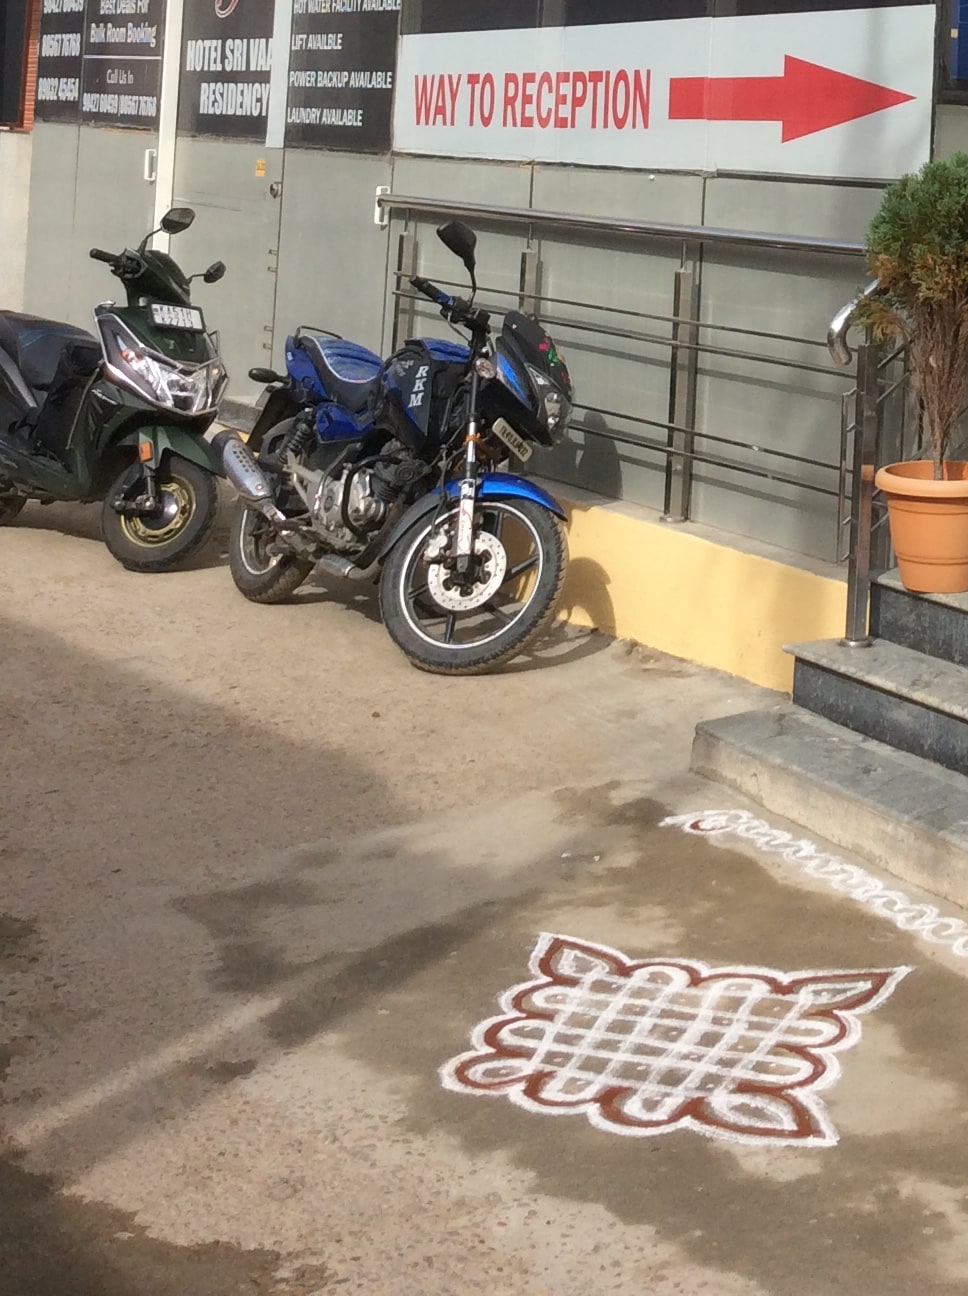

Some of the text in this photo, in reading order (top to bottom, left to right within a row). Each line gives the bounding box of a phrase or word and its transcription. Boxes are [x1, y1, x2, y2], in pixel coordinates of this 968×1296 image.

[186, 39, 222, 71] HOTEL
[224, 38, 247, 71] SRI
[291, 34, 307, 50] LIFT
[289, 71, 393, 89] POWER BACKUP AVAILABLE
[200, 82, 271, 116] RESIDENCY
[414, 68, 651, 130] WAY TO RECEPTION
[287, 107, 363, 127] LAUNDRY AVAILABLE
